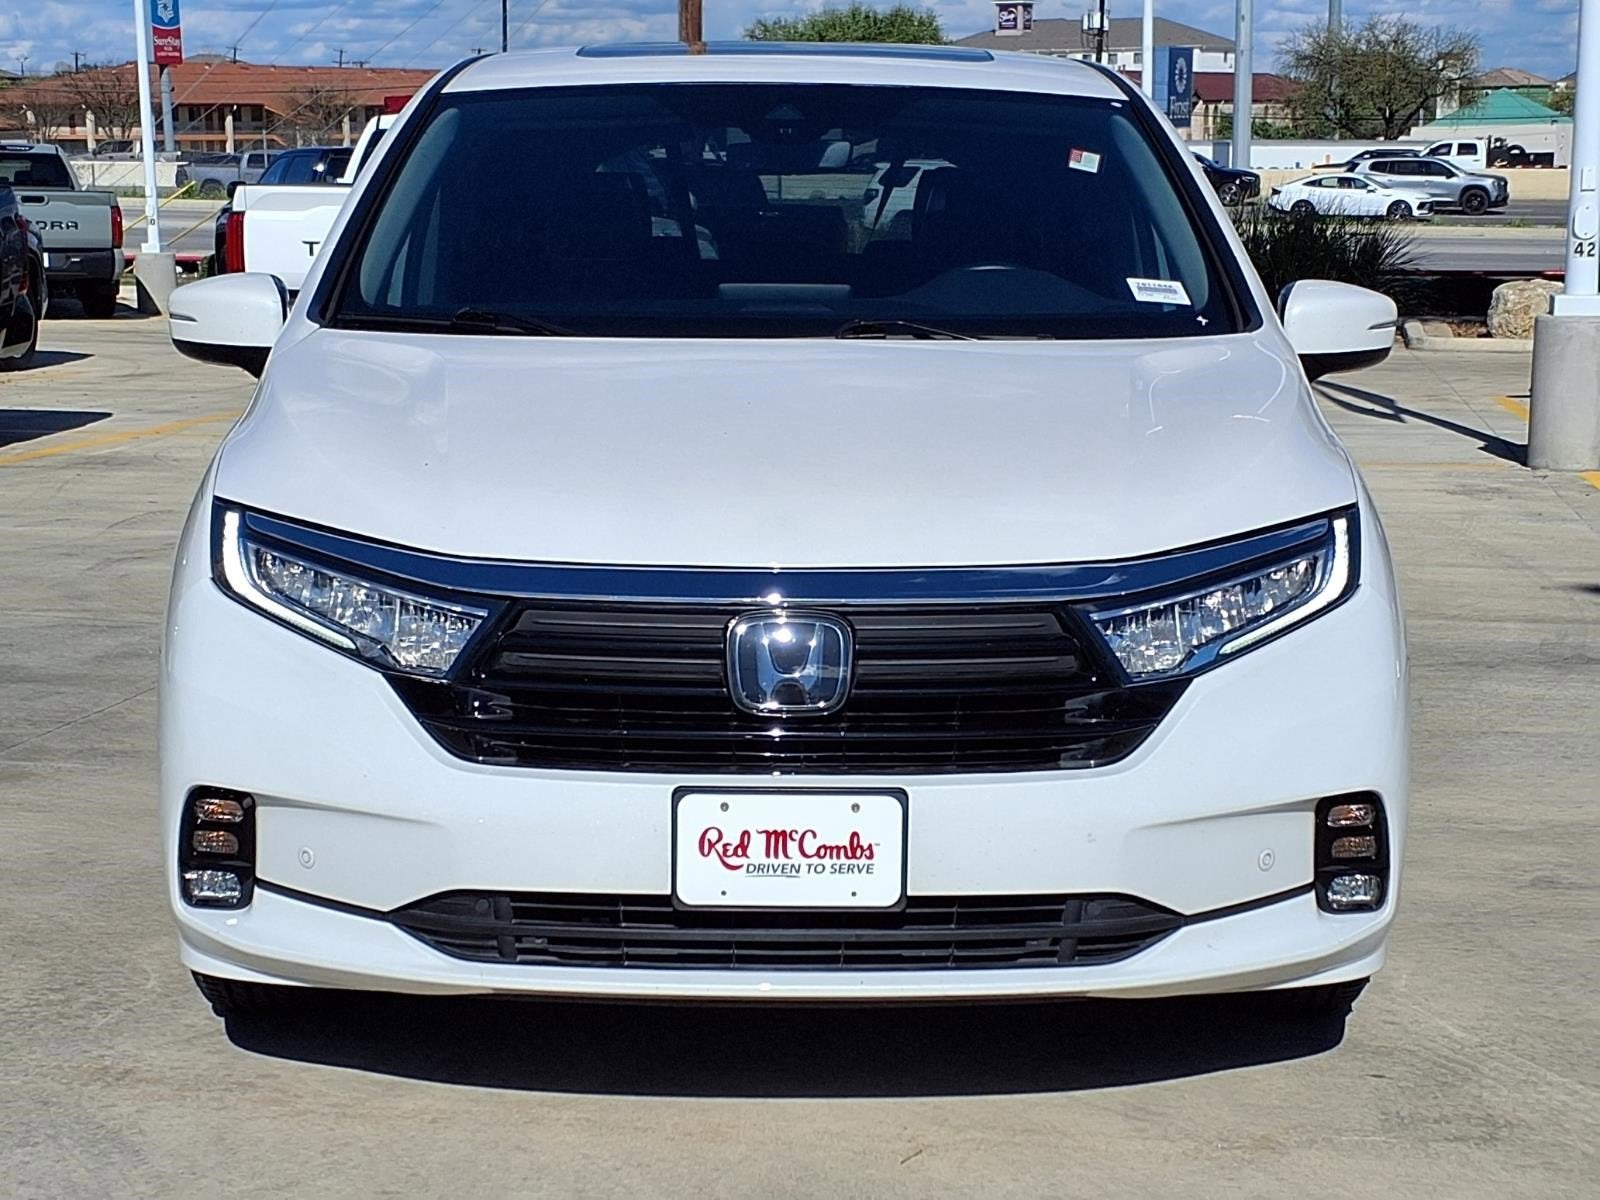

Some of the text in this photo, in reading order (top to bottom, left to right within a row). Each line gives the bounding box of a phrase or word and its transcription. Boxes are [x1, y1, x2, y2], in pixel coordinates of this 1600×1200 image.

[1574, 241, 1596, 257] 42
[699, 826, 751, 871] Red
[746, 863, 875, 875] DRIVEN TO SERVE
